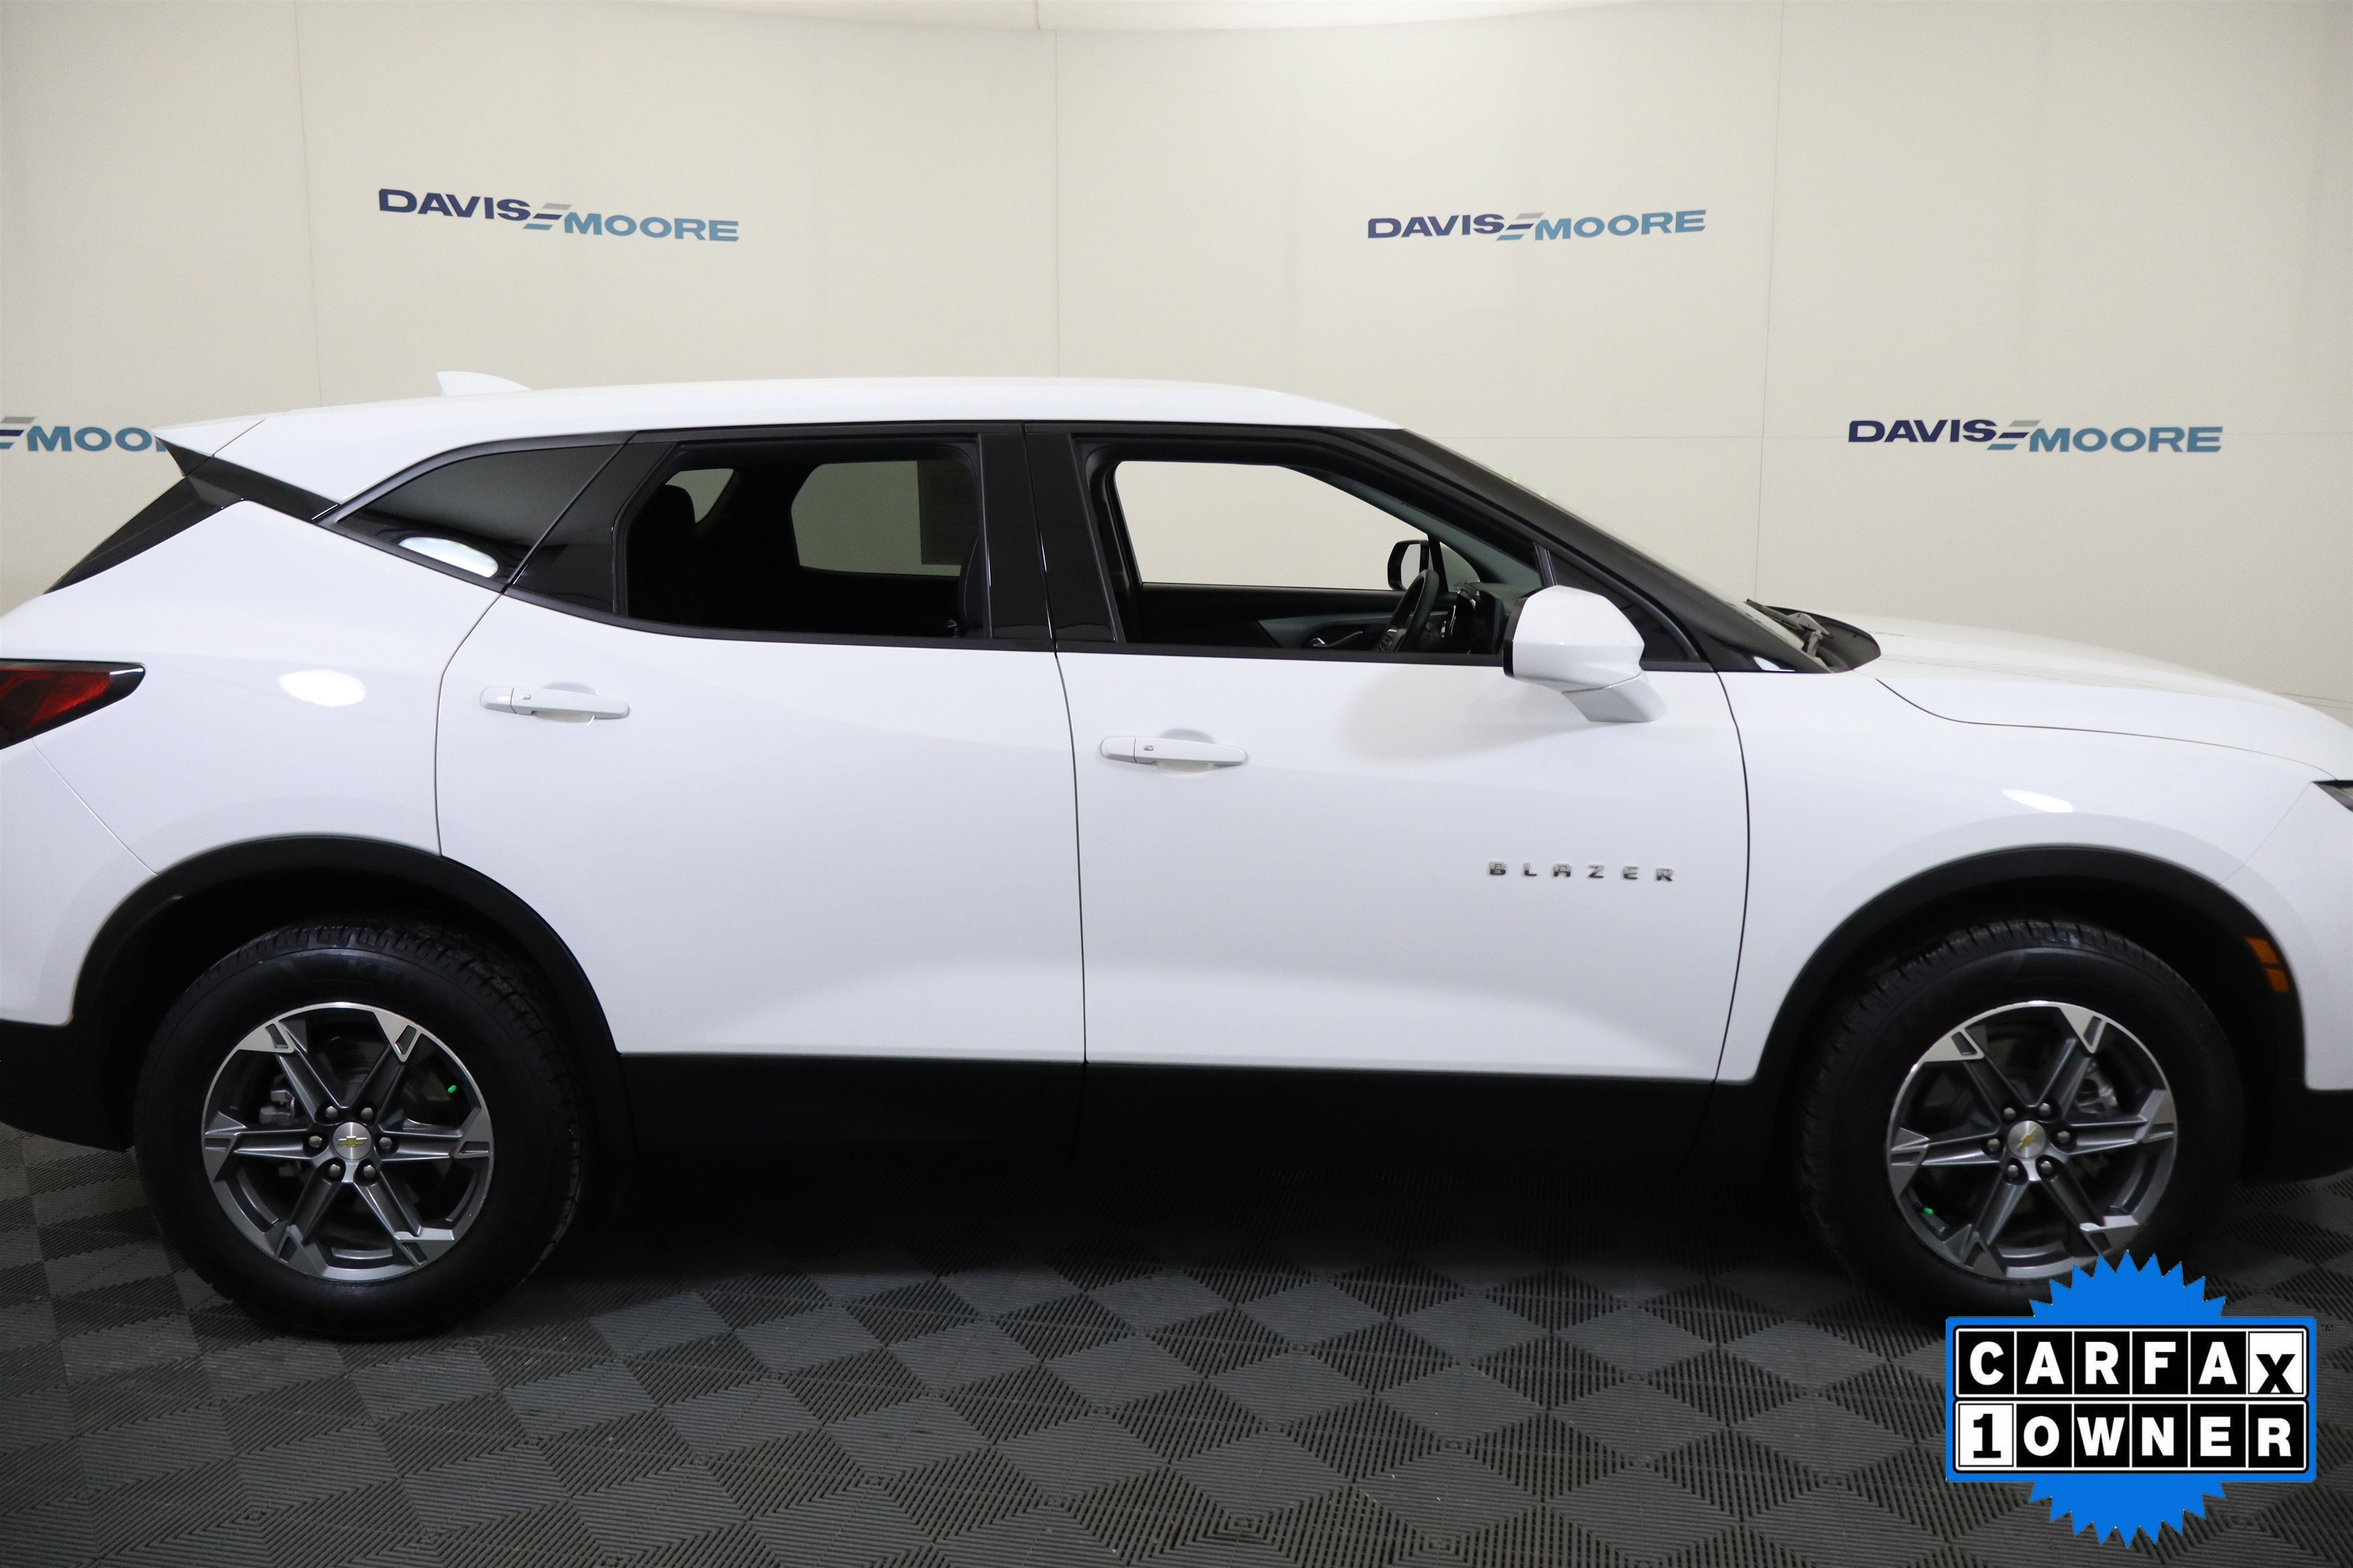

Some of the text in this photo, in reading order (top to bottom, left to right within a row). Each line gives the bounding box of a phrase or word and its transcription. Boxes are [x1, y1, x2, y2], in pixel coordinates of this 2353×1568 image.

[379, 188, 739, 242] DAVIS MOORE
[1368, 210, 1707, 241] DAVIS MOORE
[1848, 419, 2223, 453] DAVIS MOORE
[1488, 861, 1674, 882] BLAZER
